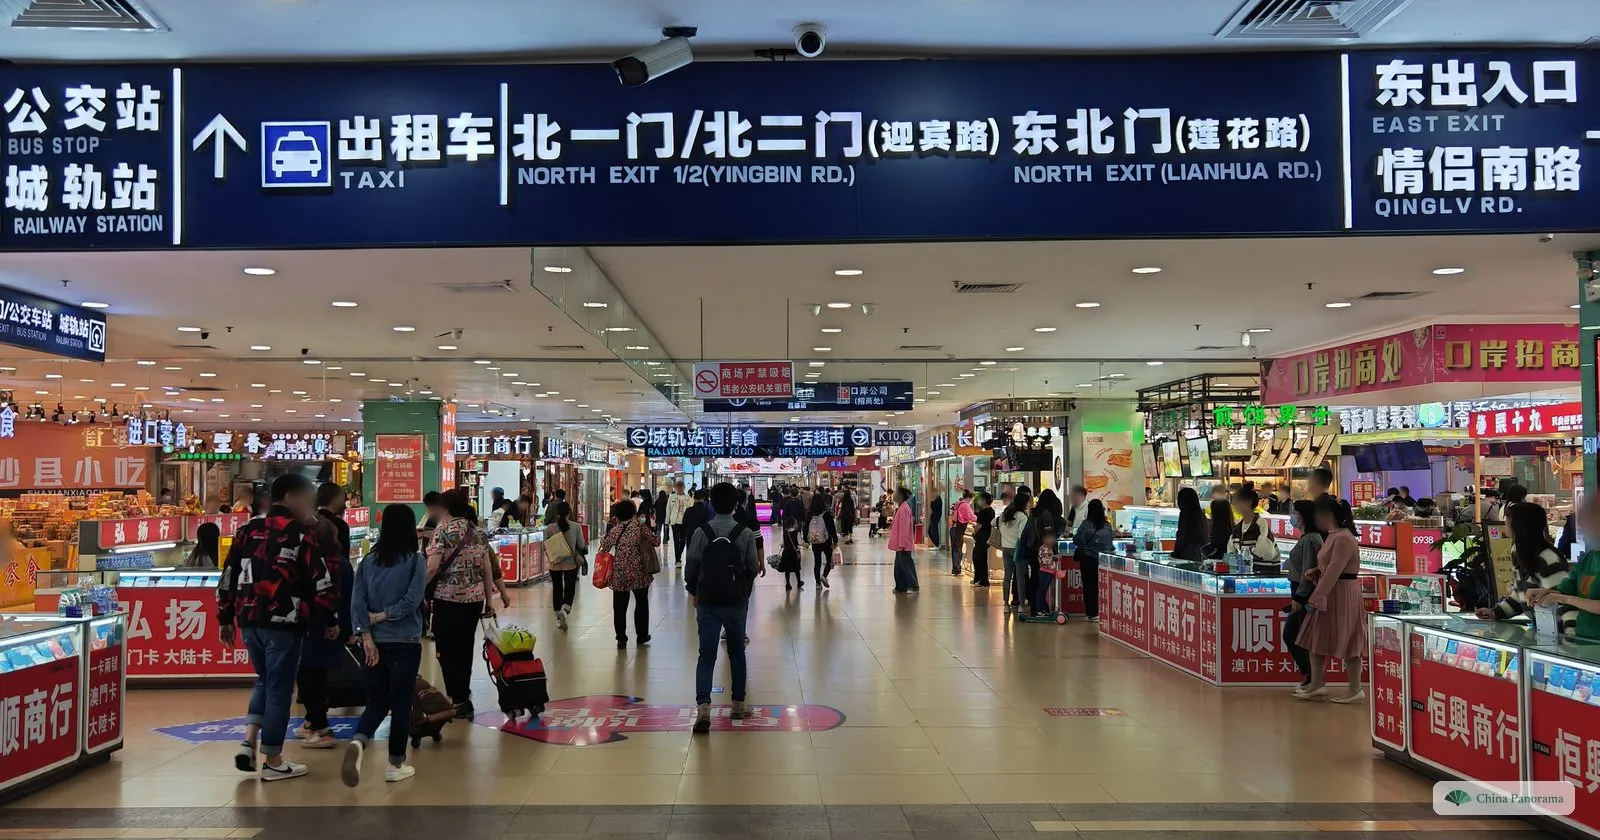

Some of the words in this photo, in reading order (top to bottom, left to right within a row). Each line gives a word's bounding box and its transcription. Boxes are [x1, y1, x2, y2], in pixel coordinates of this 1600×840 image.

[1375, 59, 1577, 107] 东出入口
[4, 83, 161, 134] 公交站
[1373, 116, 1437, 134] EAST
[1448, 115, 1506, 132] EXIT
[8, 138, 43, 155] BUS
[53, 137, 100, 154] STOP
[338, 112, 495, 162] 出租车
[340, 171, 405, 189] TAXI
[518, 167, 596, 185] NORTH
[610, 166, 660, 184] EXIT
[673, 165, 802, 187] 1/2(YINGBIN
[811, 165, 855, 186] RD.)
[1014, 165, 1092, 184] NORTH
[1106, 164, 1155, 182] EXIT
[1160, 162, 1268, 184] (LIANHUA
[1278, 161, 1322, 182] RD.)
[1376, 147, 1582, 195] 情侣南路
[5, 162, 158, 212] 城轨站
[1375, 197, 1472, 217] QINGLV
[1481, 196, 1523, 215] RD.
[14, 217, 87, 234] RAILWAY
[96, 215, 163, 233] STATION
[17, 327, 27, 337] BUS
[28, 328, 47, 341] STATION
[60, 313, 89, 338] 城轨站
[1445, 339, 1579, 369] 口岸招商
[722, 367, 791, 379] 商场严禁吸烟
[1292, 339, 1402, 396] 口岸招商处
[722, 384, 791, 395] 违者公安机关重罚
[850, 386, 888, 395] 口岸公司
[130, 419, 188, 448] 进口零食
[648, 428, 704, 447] 城轨站
[783, 430, 845, 447] 生活超市
[688, 447, 724, 455] STATION
[795, 447, 850, 456] SUPERMARKETS
[114, 519, 170, 544] 弘扬行
[1112, 579, 1145, 624] 顺商行
[1153, 590, 1196, 642] 顺商行
[90, 656, 118, 676] 一卡兩號
[164, 649, 213, 665] 大陆卡
[1232, 658, 1275, 673] 澳门卡
[89, 681, 118, 708] 澳門卡
[0, 682, 73, 756] 顺商行
[89, 711, 117, 738] 大陸卡
[1427, 688, 1521, 764] 恒興商行
